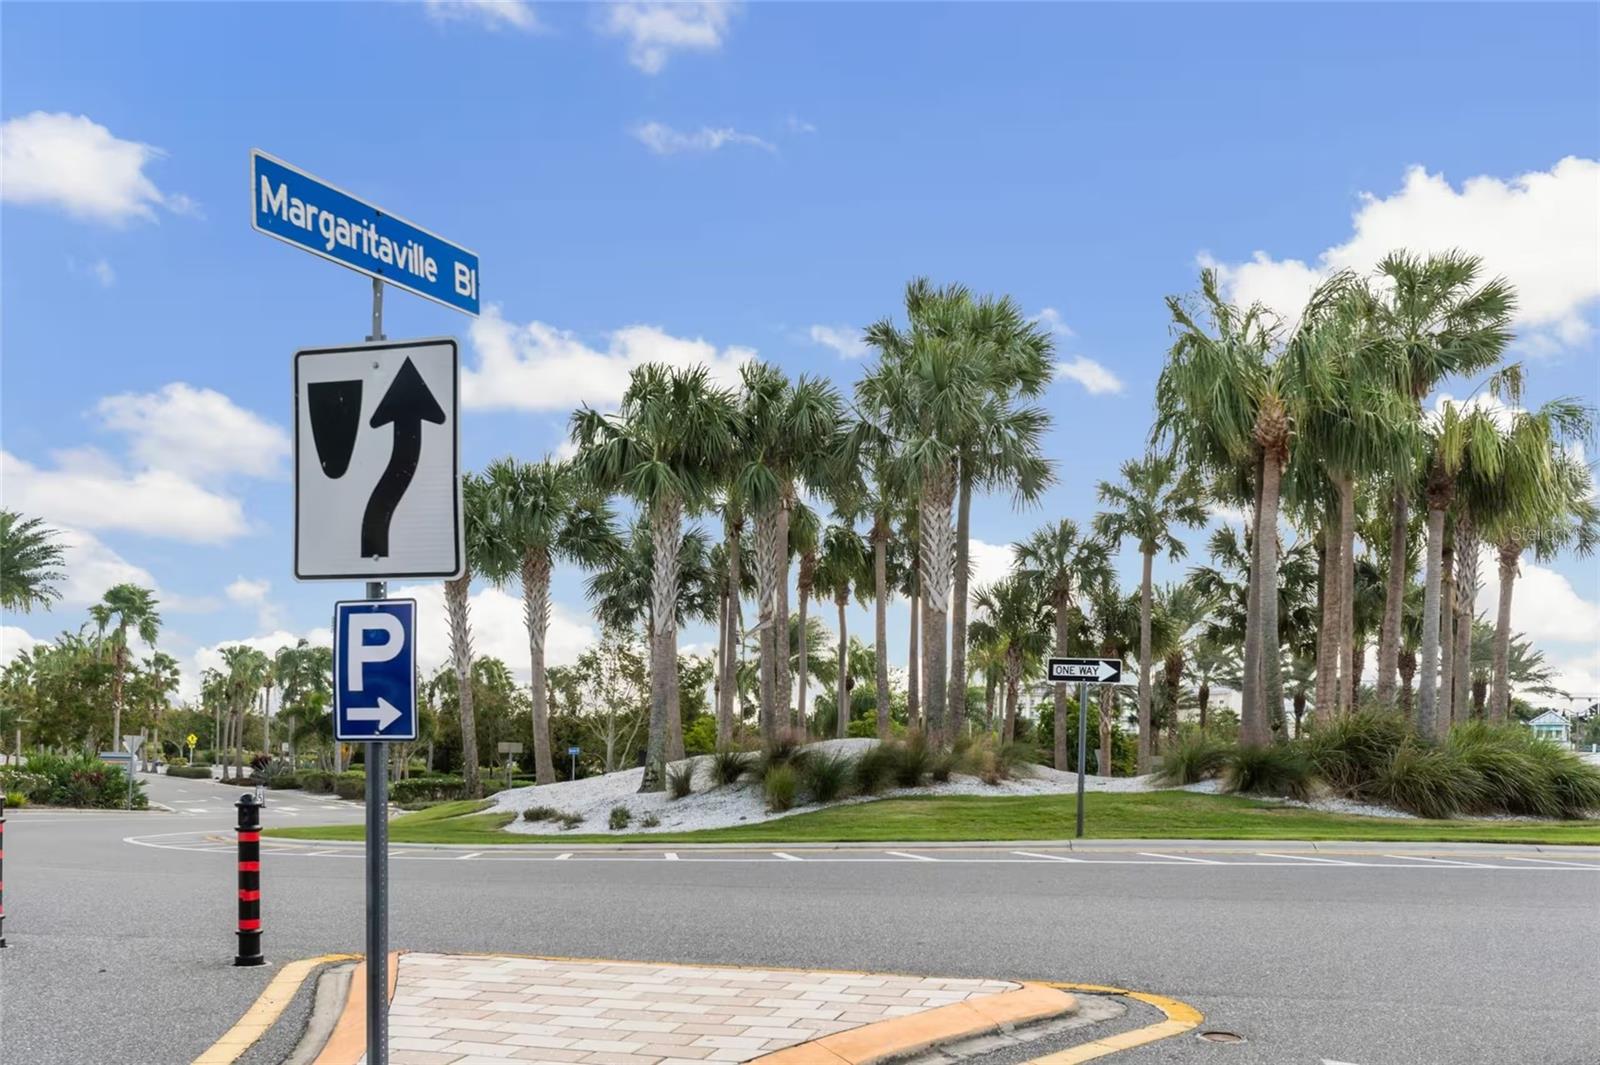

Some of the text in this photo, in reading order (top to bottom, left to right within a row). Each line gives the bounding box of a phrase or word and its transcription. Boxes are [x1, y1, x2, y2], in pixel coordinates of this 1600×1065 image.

[261, 174, 438, 282] Margaritaville
[348, 613, 405, 691] P
[1055, 666, 1099, 676] ONE WAY
